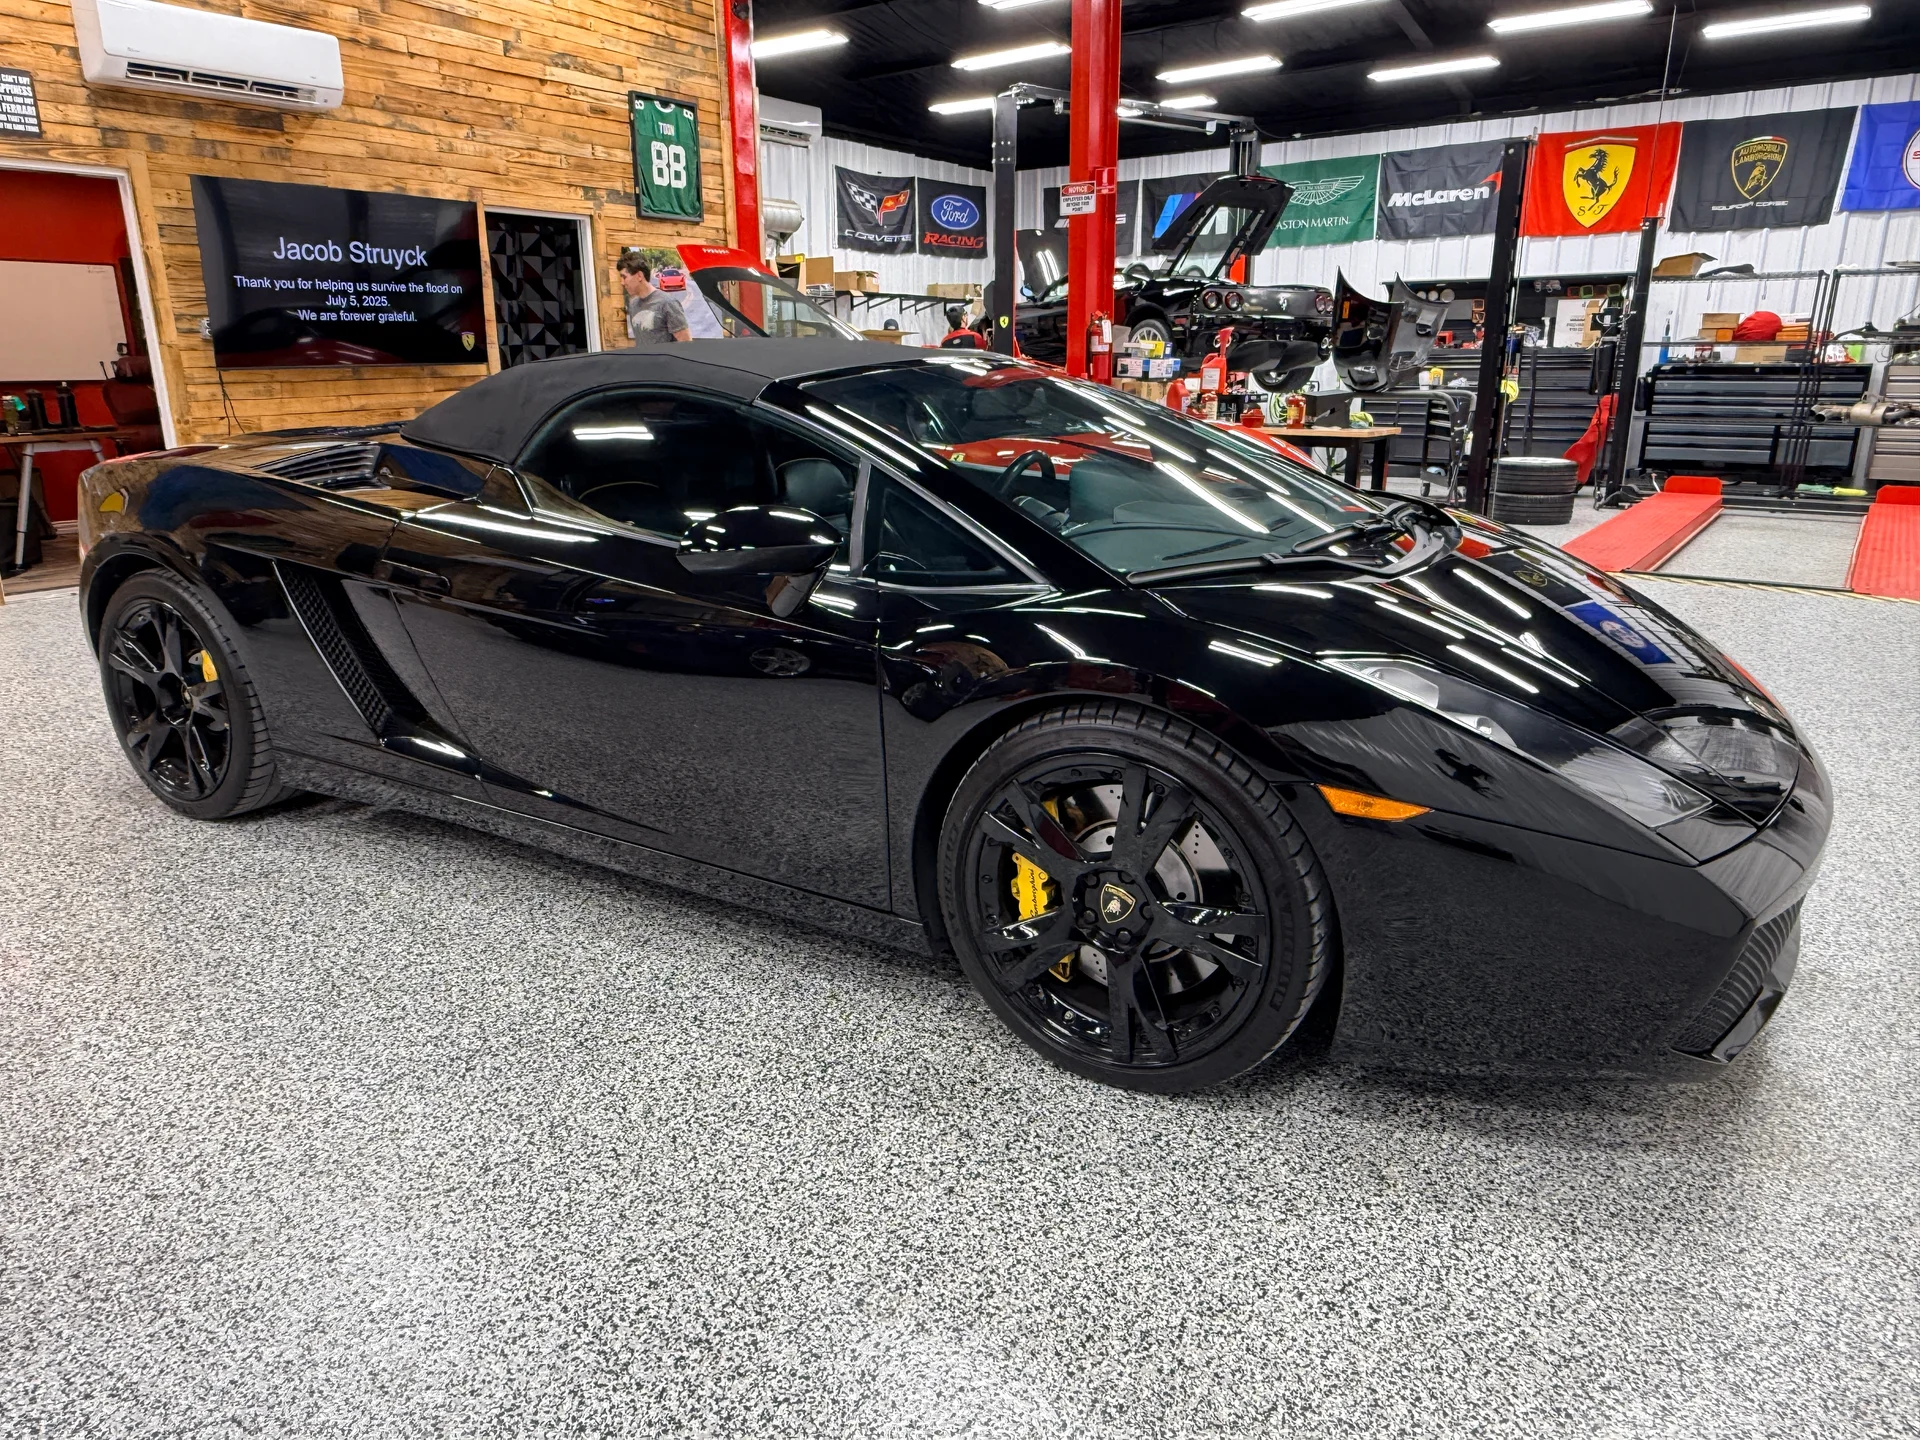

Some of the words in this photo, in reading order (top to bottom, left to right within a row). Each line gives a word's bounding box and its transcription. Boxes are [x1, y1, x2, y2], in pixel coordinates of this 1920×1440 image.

[651, 141, 687, 189] 88
[1068, 185, 1088, 194] NOTICE
[1387, 186, 1489, 207] McLaren
[941, 200, 970, 224] Ford
[1276, 219, 1309, 230] ASTON
[1310, 216, 1349, 227] MARTIN
[844, 229, 912, 243] CORVETTE
[923, 231, 985, 249] RACING
[273, 237, 343, 262] Jacob
[350, 240, 428, 270] Struyck
[233, 275, 271, 289] Thank
[273, 280, 295, 291] you
[297, 278, 313, 290] for
[315, 279, 354, 293] helping
[356, 282, 369, 291] us
[371, 282, 407, 292] survive
[408, 283, 424, 293] the
[426, 283, 449, 294] flood
[451, 286, 463, 294] on
[325, 295, 347, 308] July
[350, 296, 360, 308] 5,
[362, 296, 391, 307] 2025.
[297, 309, 317, 321] We
[320, 312, 338, 321] are
[340, 310, 375, 322] forever
[378, 311, 417, 324] grateful.
